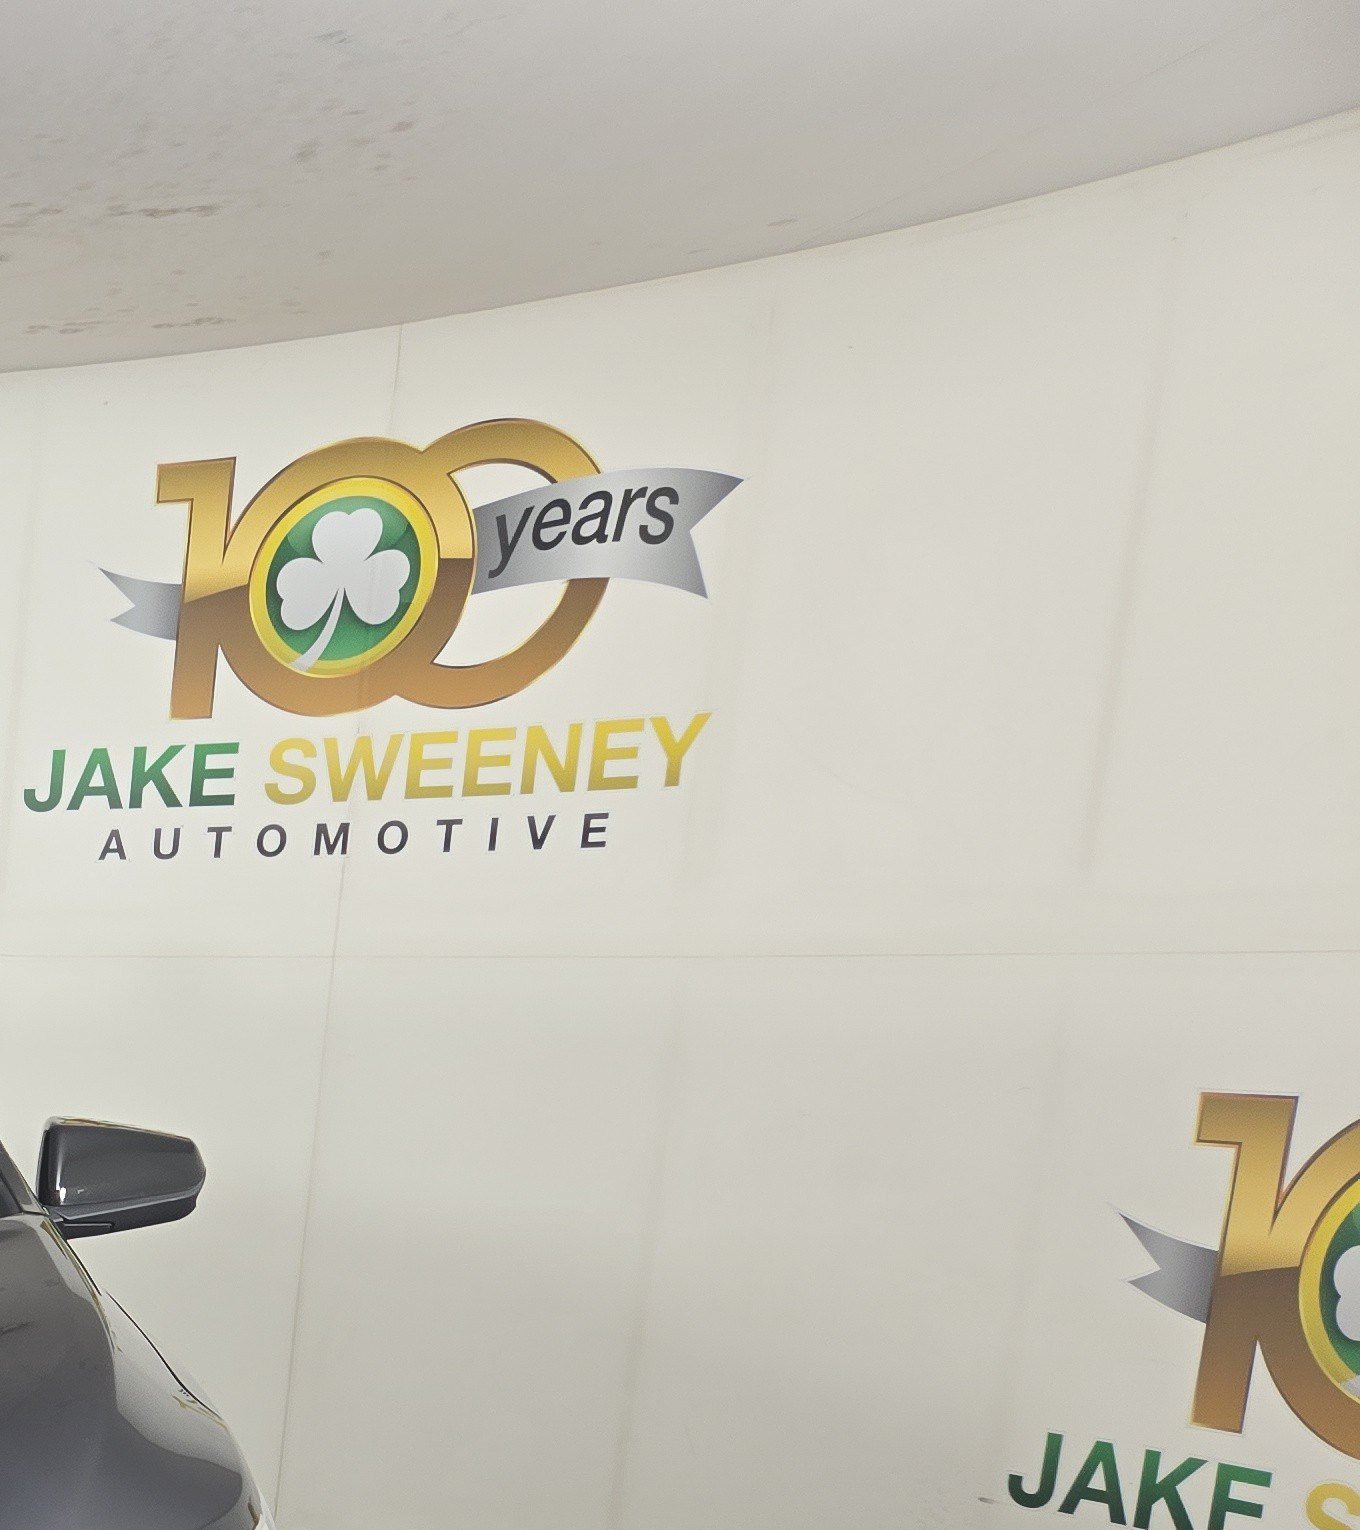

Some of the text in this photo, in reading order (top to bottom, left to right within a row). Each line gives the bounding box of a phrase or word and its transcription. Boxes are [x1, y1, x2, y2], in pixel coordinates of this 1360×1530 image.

[156, 418, 680, 719] 100 years
[23, 713, 712, 813] JAKE SWEENEY
[98, 813, 610, 862] AUTOMOTIVE
